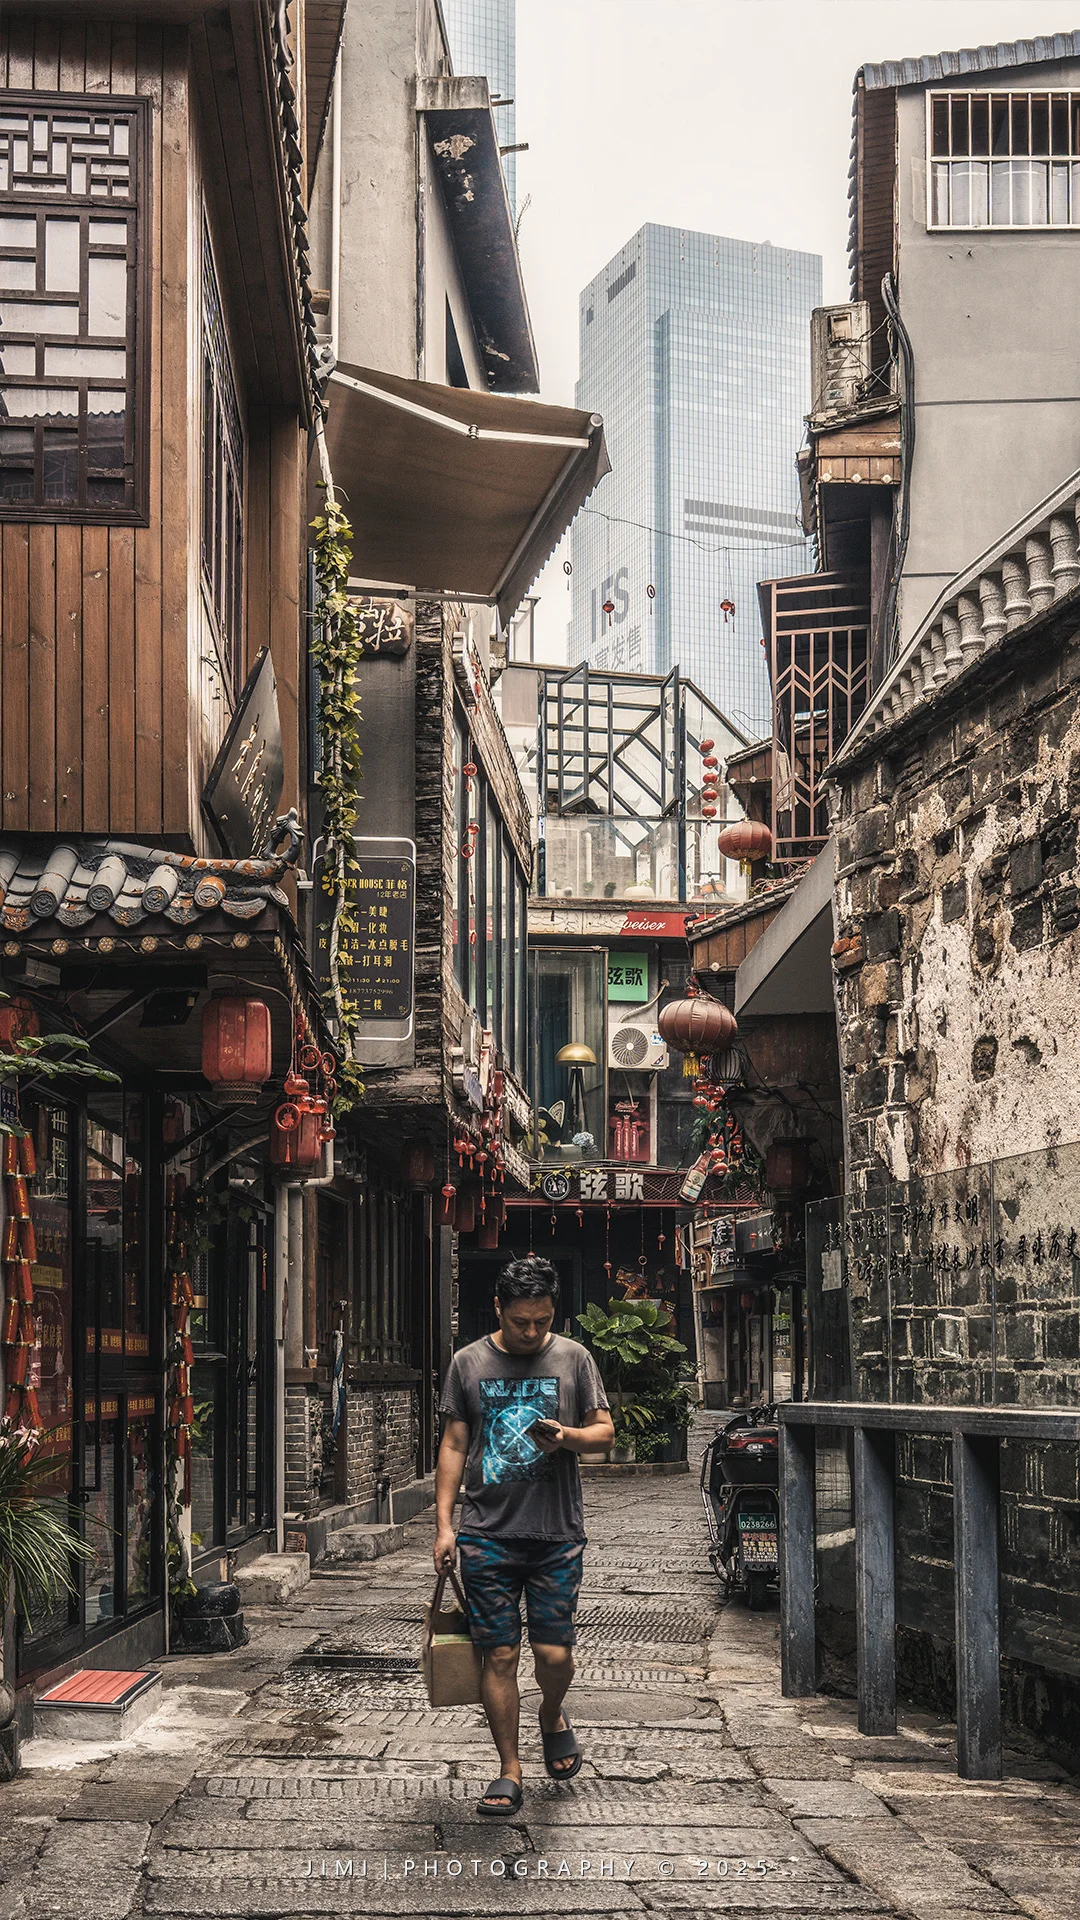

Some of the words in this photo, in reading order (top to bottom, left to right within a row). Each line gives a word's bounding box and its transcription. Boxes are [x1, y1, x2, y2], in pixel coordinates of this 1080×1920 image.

[592, 567, 629, 643] IFS
[360, 878, 384, 889] HOUSE
[608, 966, 643, 986] 弦歌
[579, 1172, 644, 1201] 弦歌
[902, 1194, 979, 1238] 守护中华文明
[925, 1235, 1006, 1279] 讲述长沙故事
[740, 1520, 776, 1529] 0238266
